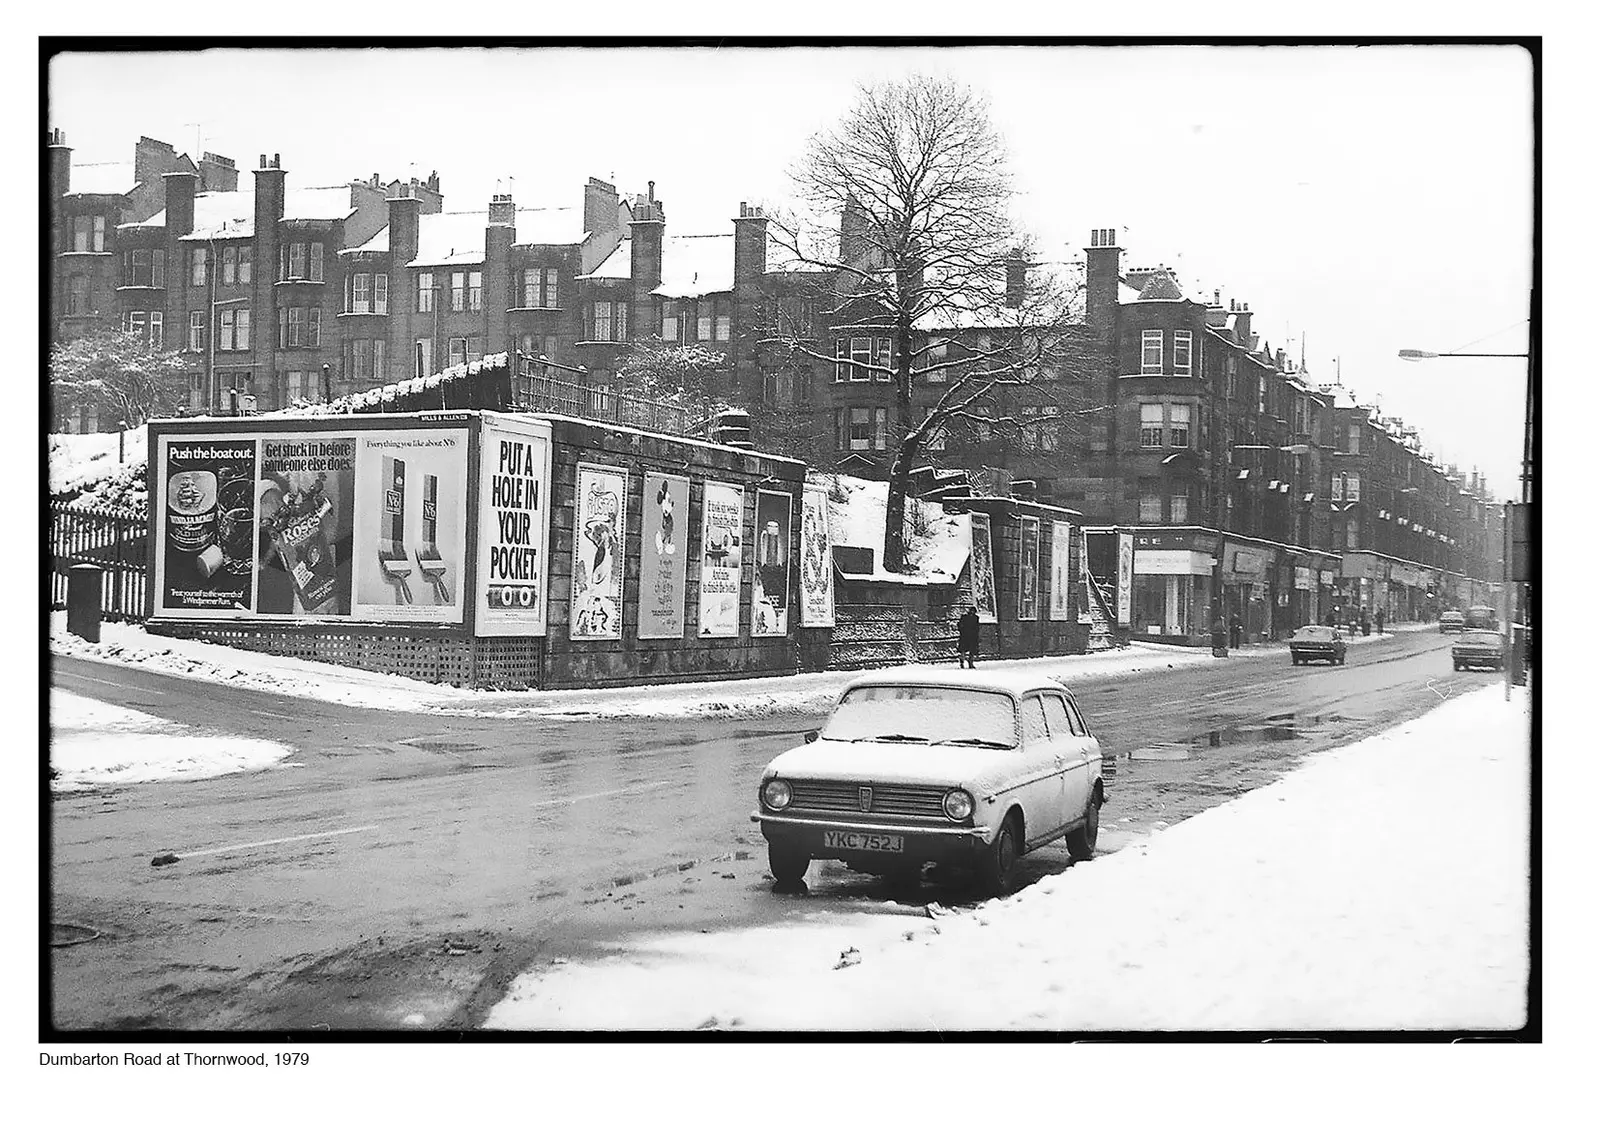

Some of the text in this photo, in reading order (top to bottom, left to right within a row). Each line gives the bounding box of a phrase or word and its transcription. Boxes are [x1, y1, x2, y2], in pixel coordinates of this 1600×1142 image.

[170, 446, 254, 460] Push the boat out.
[265, 442, 351, 458] Get stuck in before
[366, 439, 400, 449] Everything
[401, 441, 412, 449] you
[413, 439, 424, 447] like
[264, 459, 307, 472] someone
[308, 457, 327, 472] else
[499, 440, 534, 477] PUT A
[491, 475, 539, 511] HOLE IN
[281, 517, 321, 545] Roses
[497, 511, 531, 546] YOUR
[490, 546, 537, 580] POCKET.
[827, 832, 902, 851] YKC 752J
